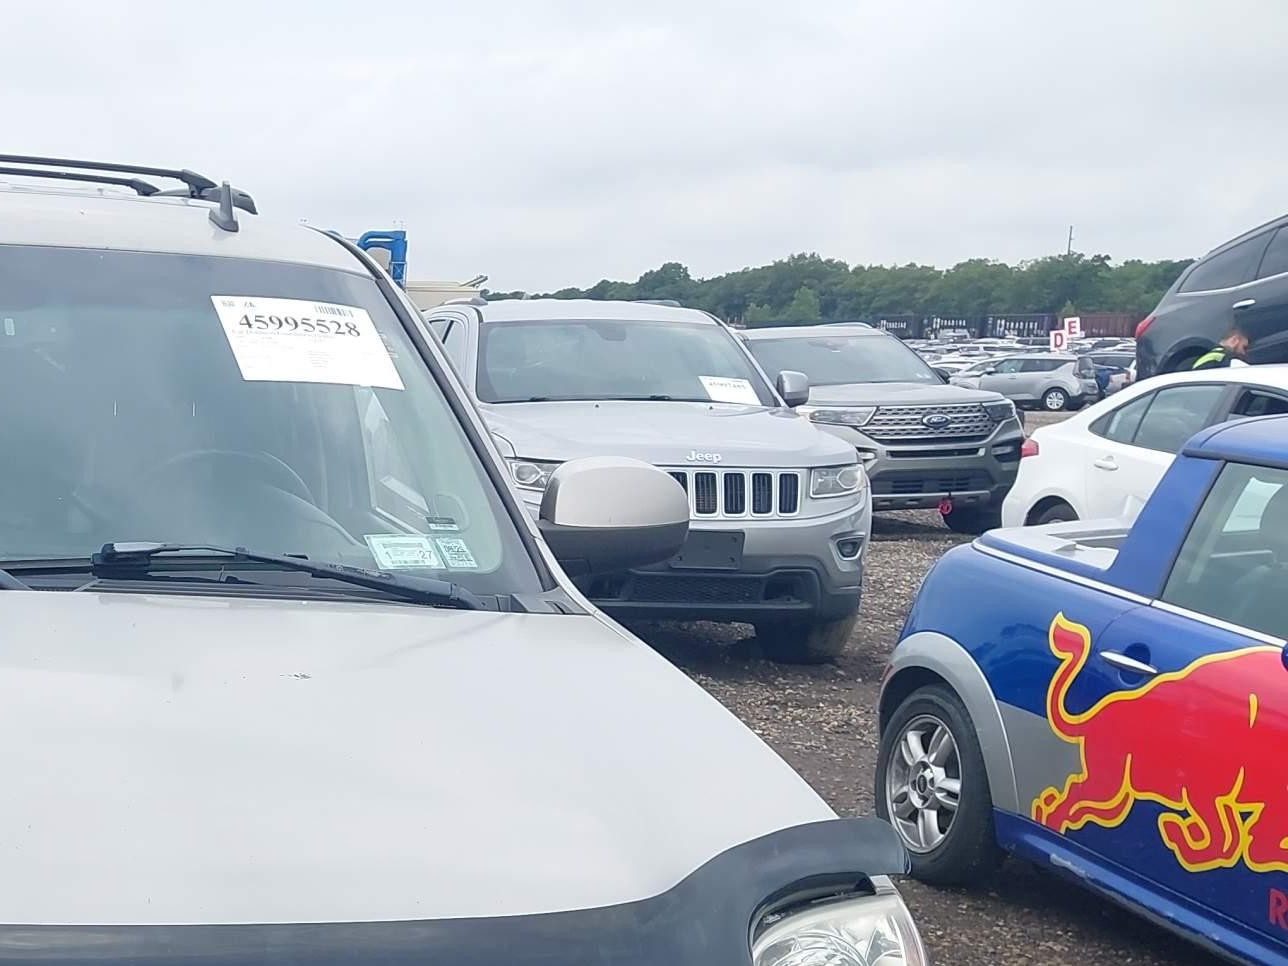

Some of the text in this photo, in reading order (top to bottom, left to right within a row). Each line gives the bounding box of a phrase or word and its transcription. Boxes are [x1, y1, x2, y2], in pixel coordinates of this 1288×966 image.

[238, 312, 361, 338] 45995528
[1068, 320, 1077, 335] E
[1054, 333, 1063, 348] D
[686, 450, 721, 463] Jeep
